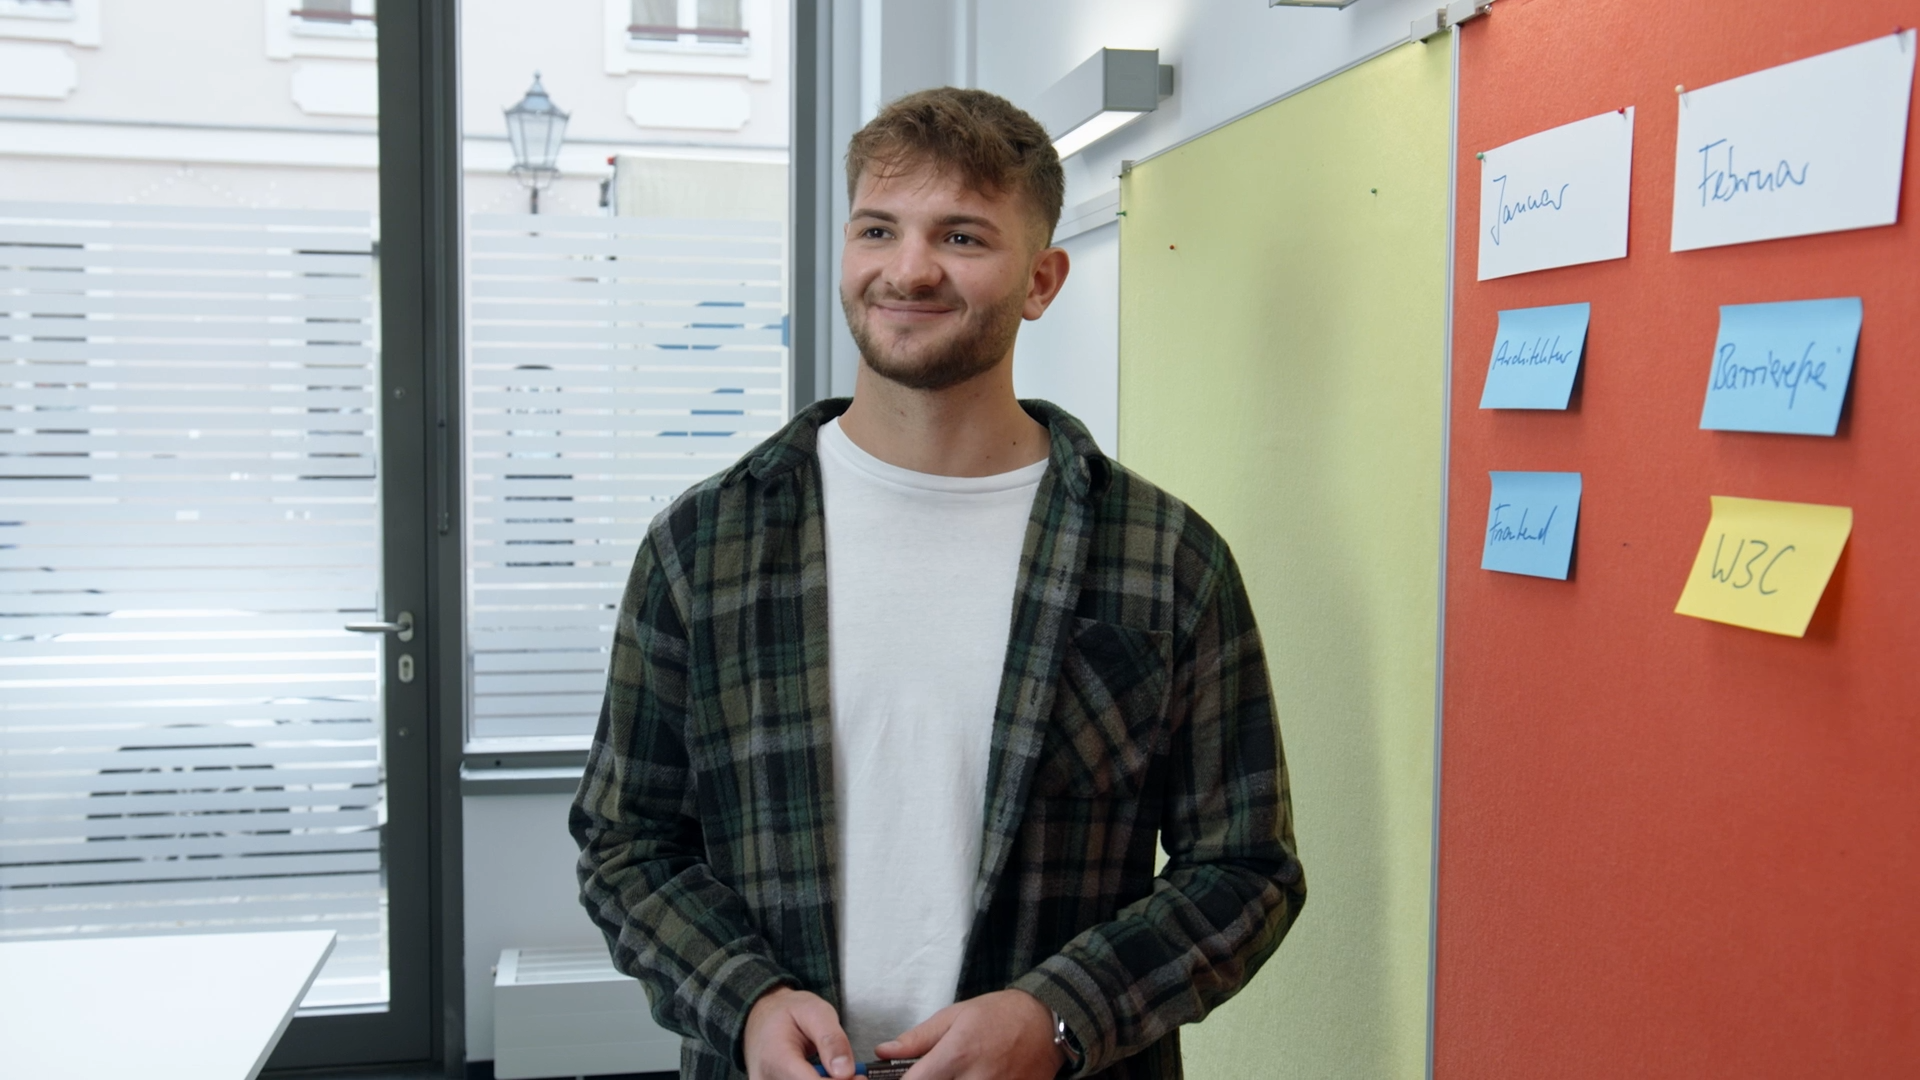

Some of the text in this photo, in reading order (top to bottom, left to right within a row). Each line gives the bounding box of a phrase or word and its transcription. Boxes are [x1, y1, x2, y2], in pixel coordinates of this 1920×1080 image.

[1698, 138, 1810, 207] Februar
[1490, 174, 1570, 246] Januar
[1492, 335, 1573, 370] Architektur
[1489, 503, 1558, 546] Frontend
[1710, 533, 1796, 595] W3C
